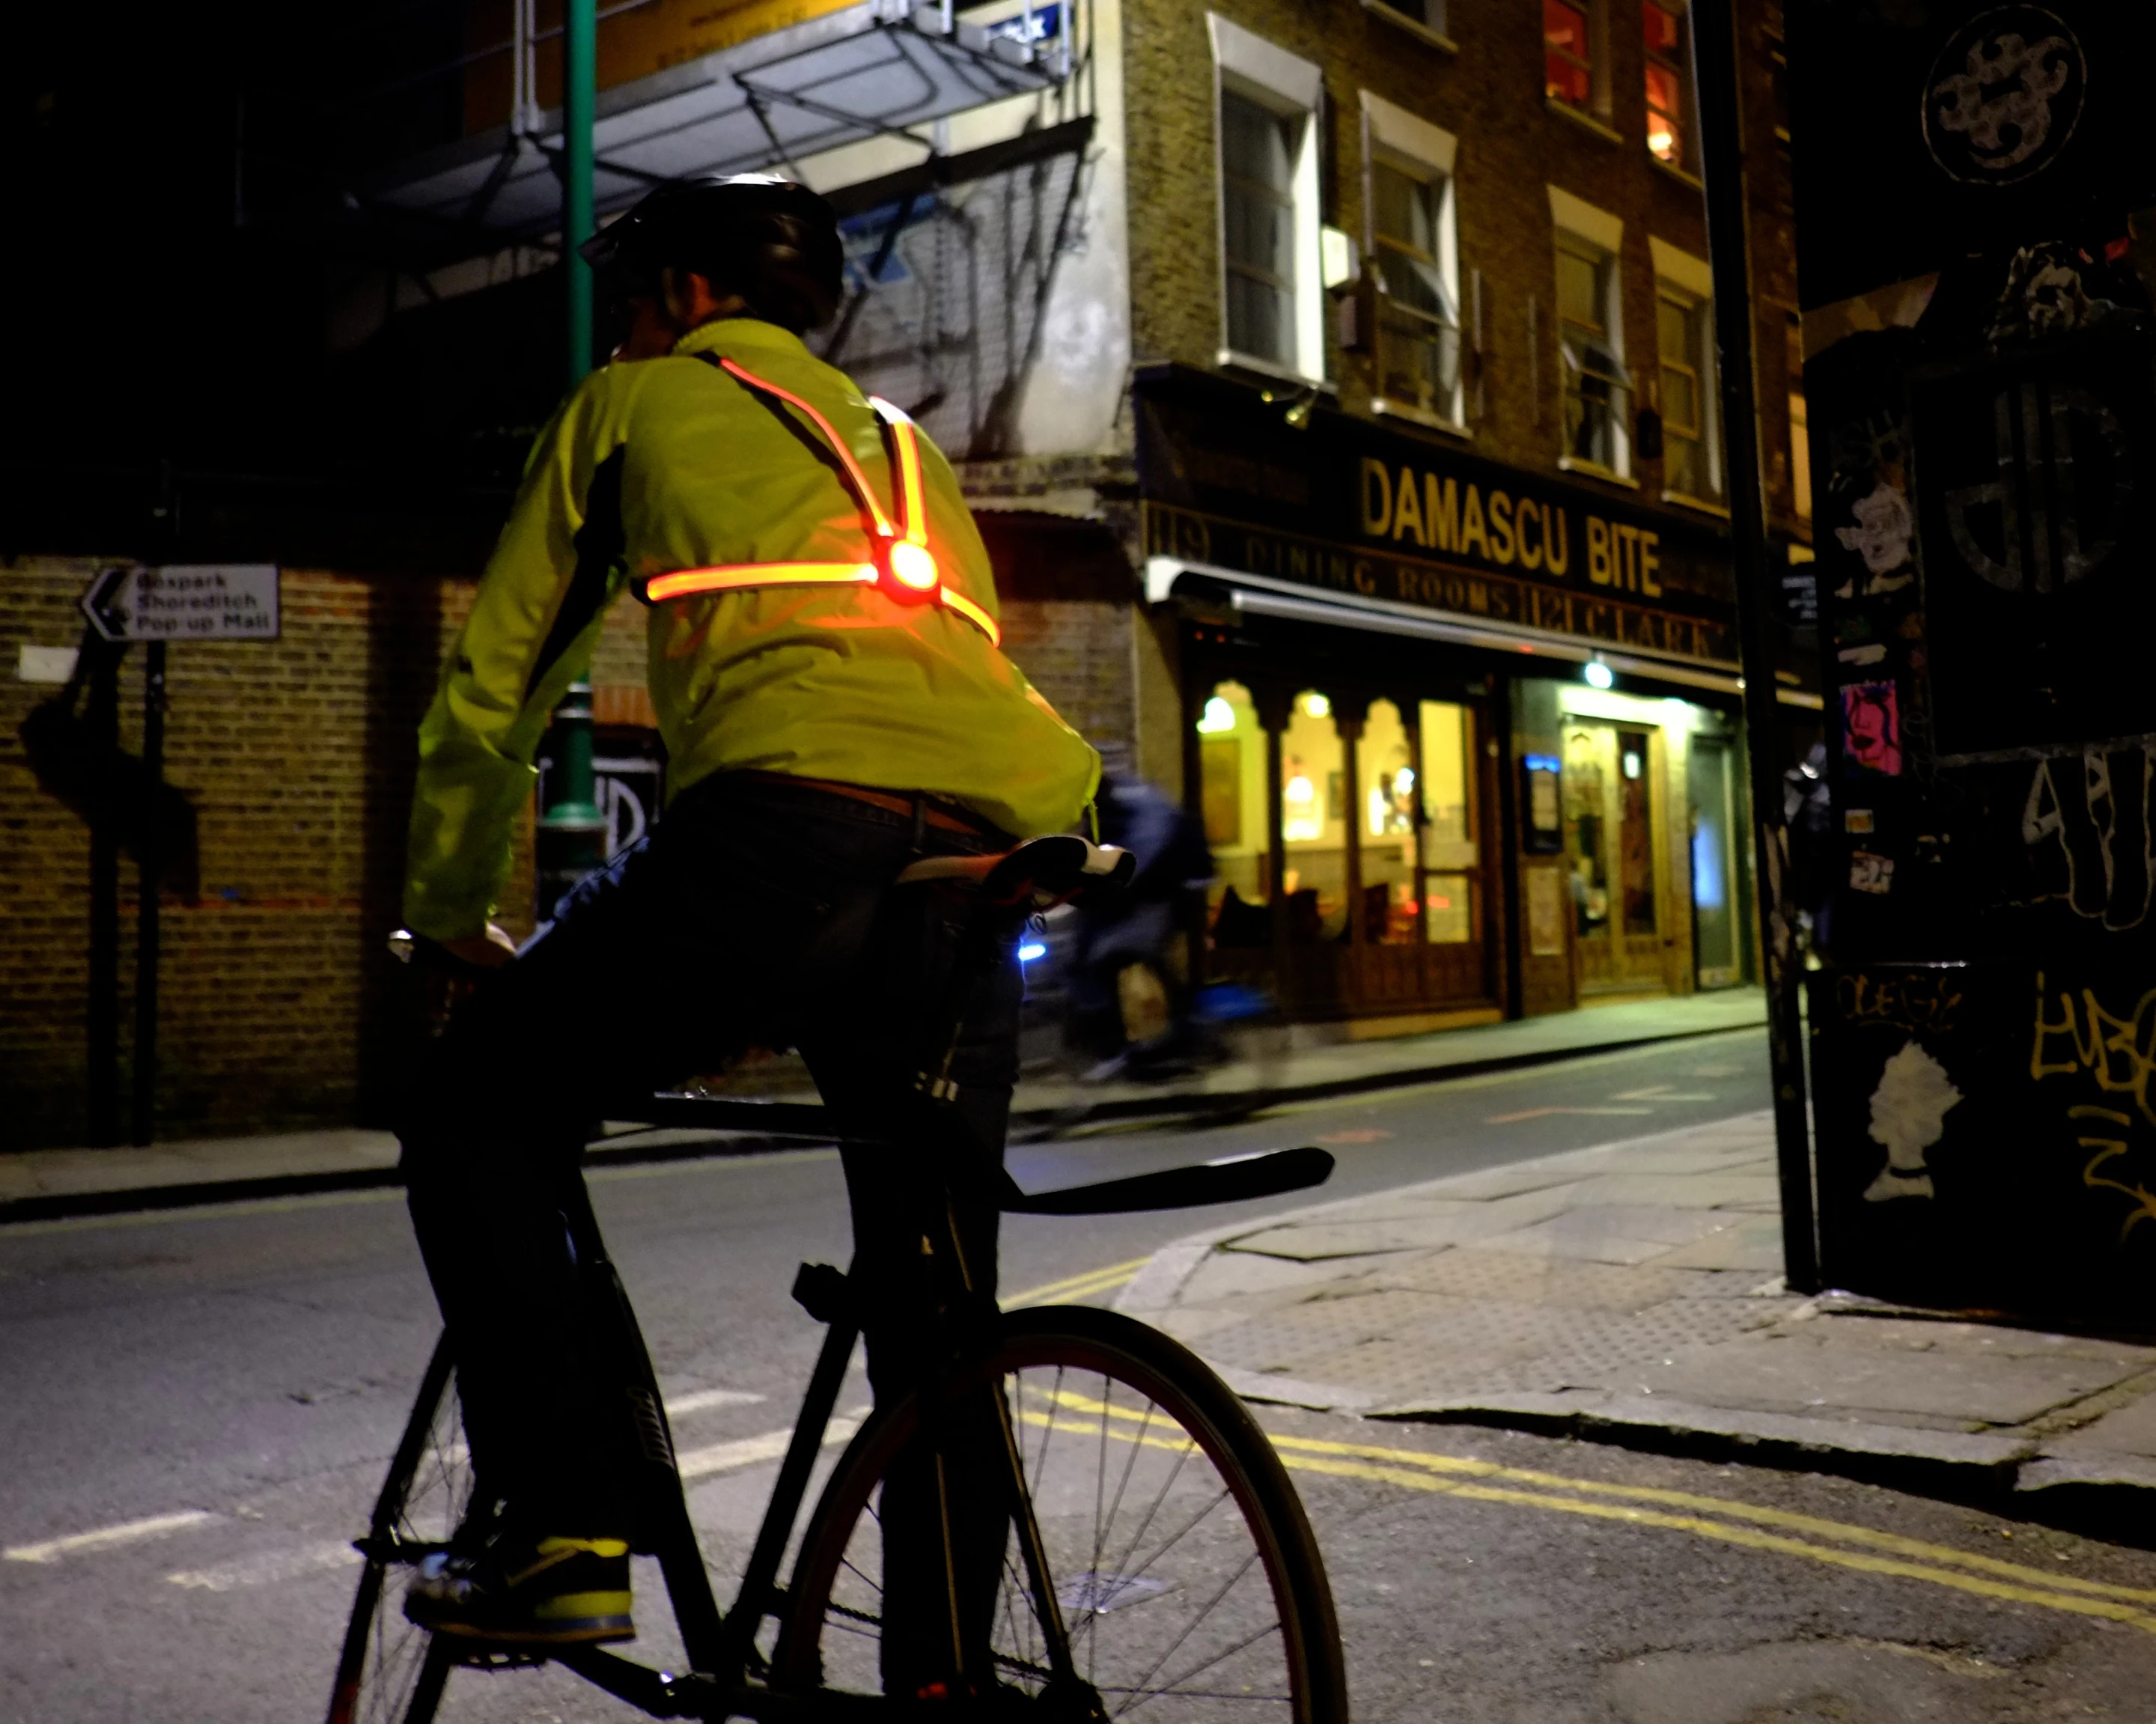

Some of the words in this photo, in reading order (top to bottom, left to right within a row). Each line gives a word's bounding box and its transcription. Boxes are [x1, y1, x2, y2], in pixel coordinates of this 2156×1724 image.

[1359, 456, 1569, 577] DAMASCU
[1583, 514, 1663, 599] BITE
[137, 593, 257, 609] Shoreditch
[1245, 534, 1377, 596] DINING
[1397, 567, 1511, 619] ROOMS
[223, 612, 270, 629] Mall
